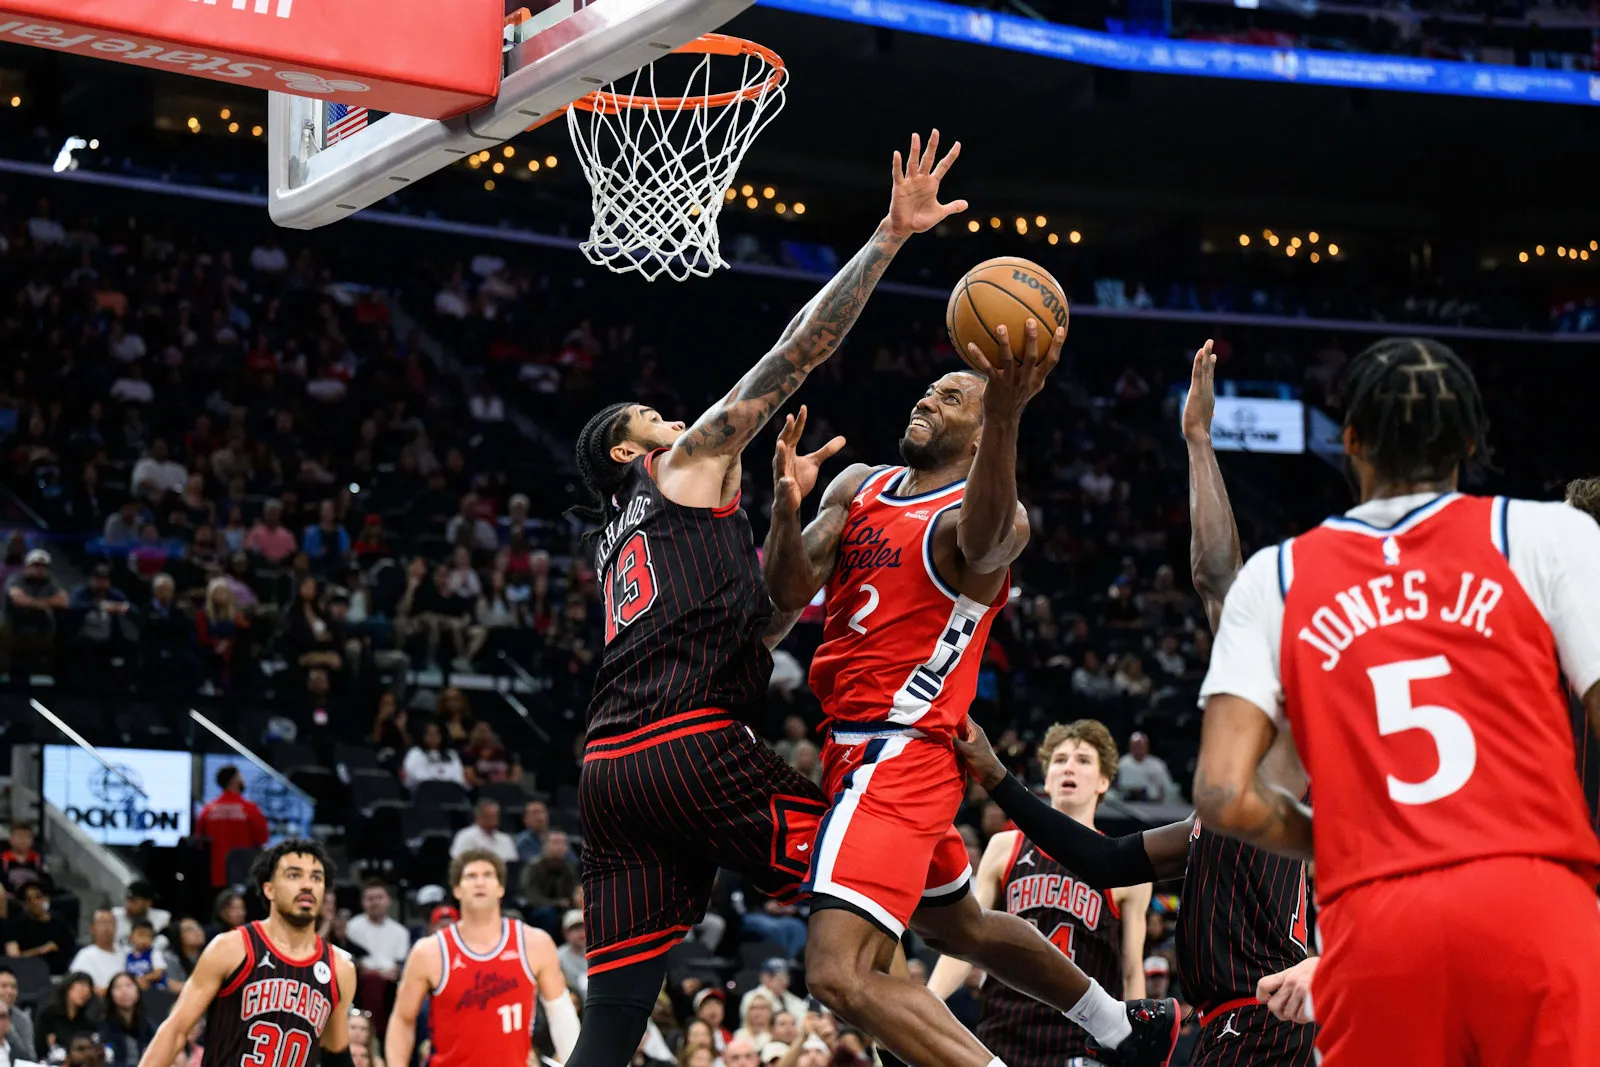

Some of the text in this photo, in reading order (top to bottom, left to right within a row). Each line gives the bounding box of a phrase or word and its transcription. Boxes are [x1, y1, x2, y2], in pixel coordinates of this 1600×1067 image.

[843, 515, 884, 546] Los
[604, 529, 658, 647] 13
[838, 538, 902, 585] ngeles
[848, 583, 880, 635] 2
[1298, 569, 1503, 672] JONES JR.
[1366, 654, 1477, 805] 5
[1007, 873, 1103, 932] CHICAGO
[241, 977, 332, 1038] CHICAGO
[497, 1002, 523, 1034] 11
[240, 1020, 313, 1067] 30
